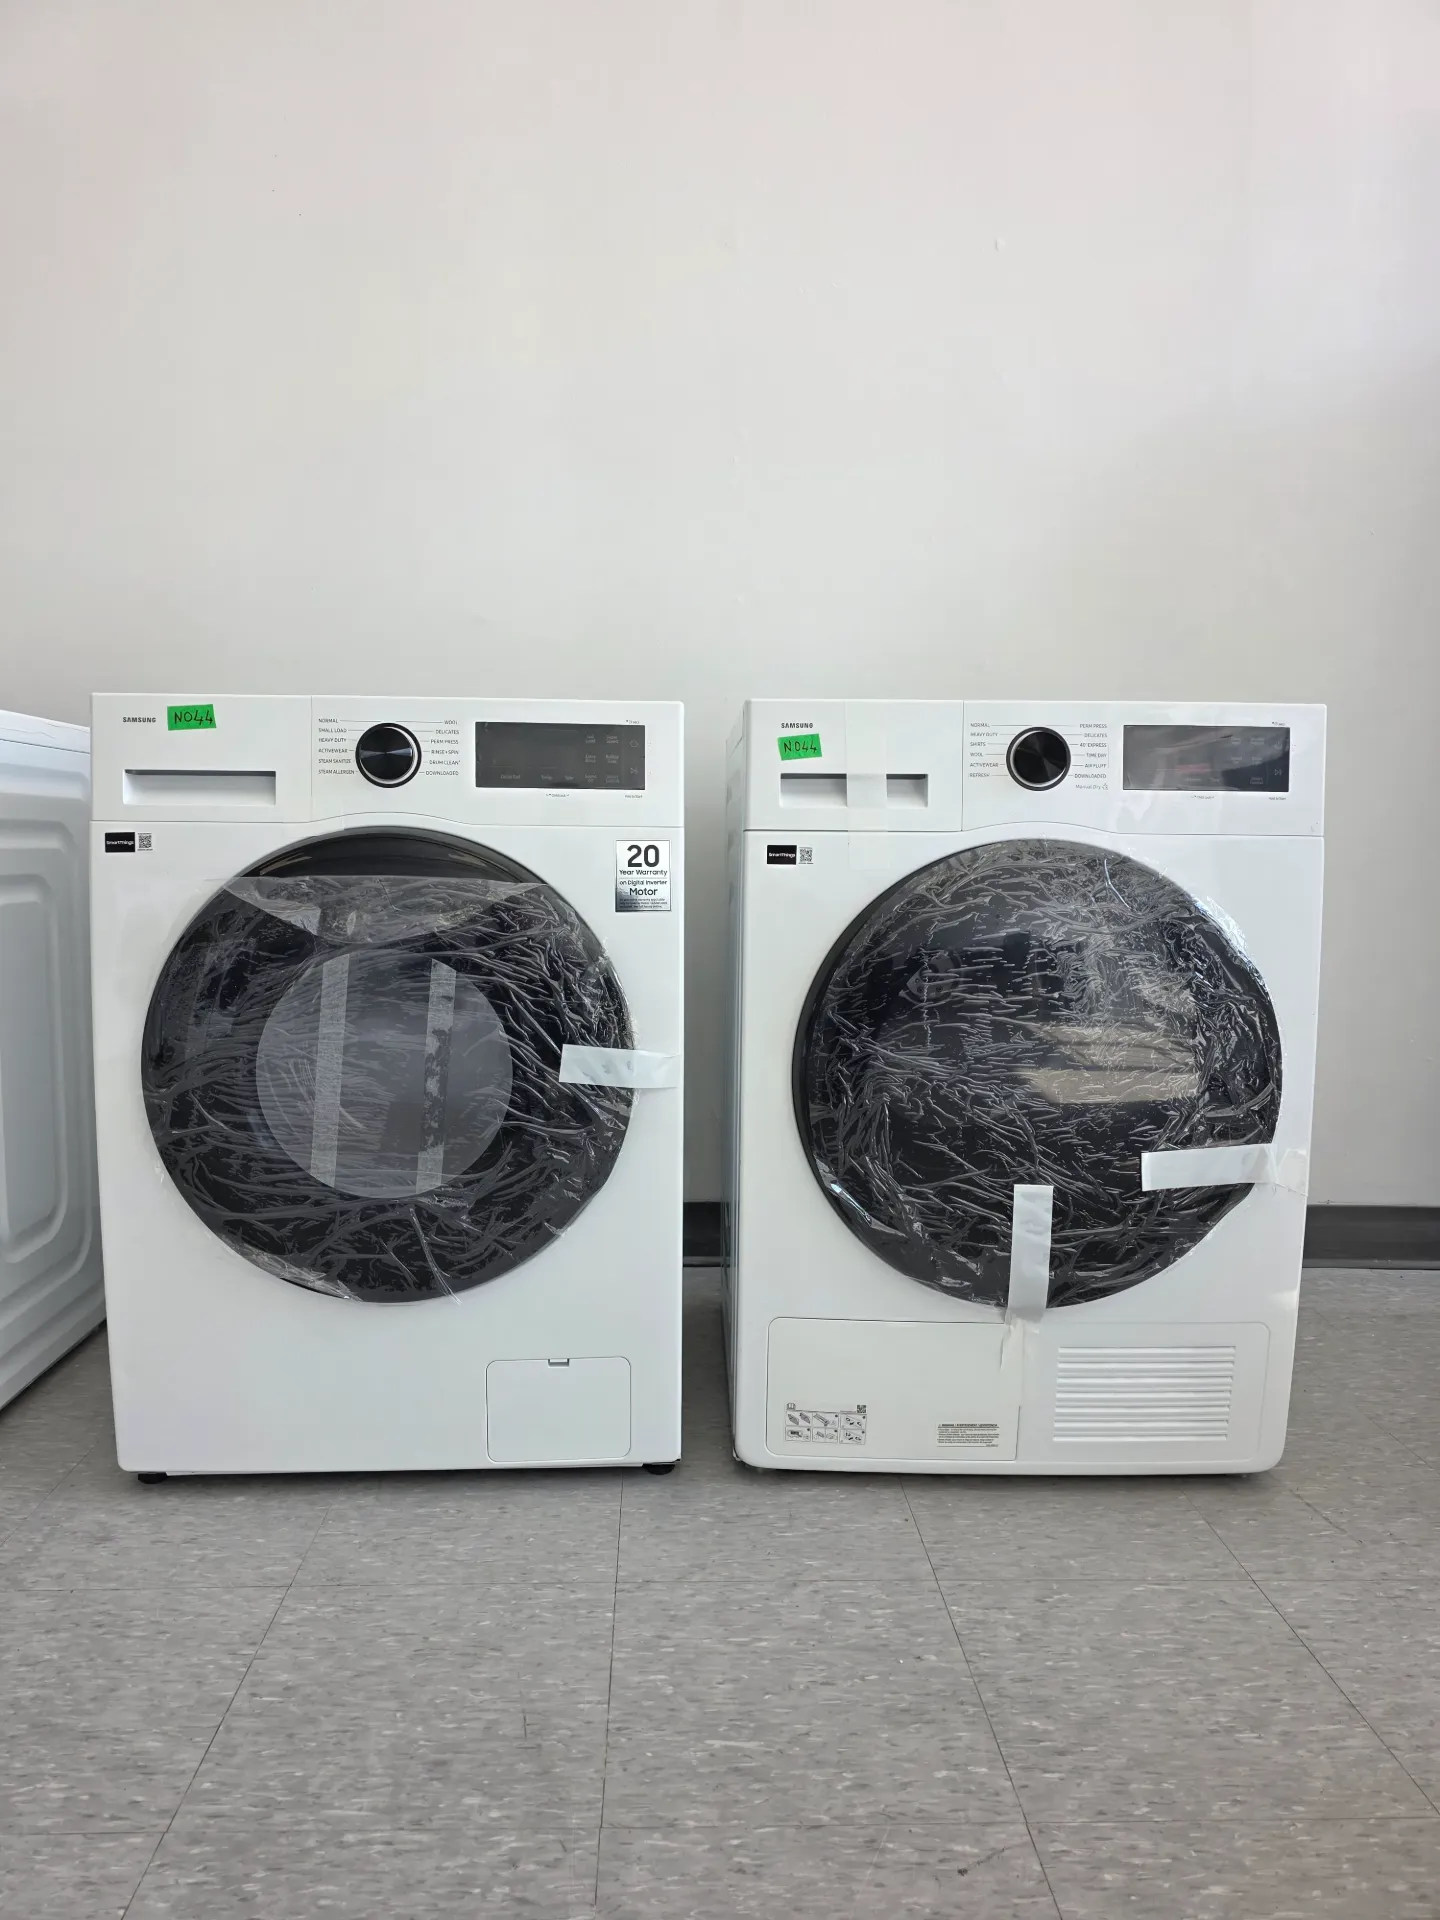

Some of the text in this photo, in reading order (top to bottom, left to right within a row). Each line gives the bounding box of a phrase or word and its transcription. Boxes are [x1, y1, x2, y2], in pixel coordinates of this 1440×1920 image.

[122, 716, 157, 724] SAMSUNG
[627, 844, 660, 868] 20
[635, 869, 668, 877] Warranty
[627, 879, 644, 887] Digital
[629, 888, 658, 896] Motor
